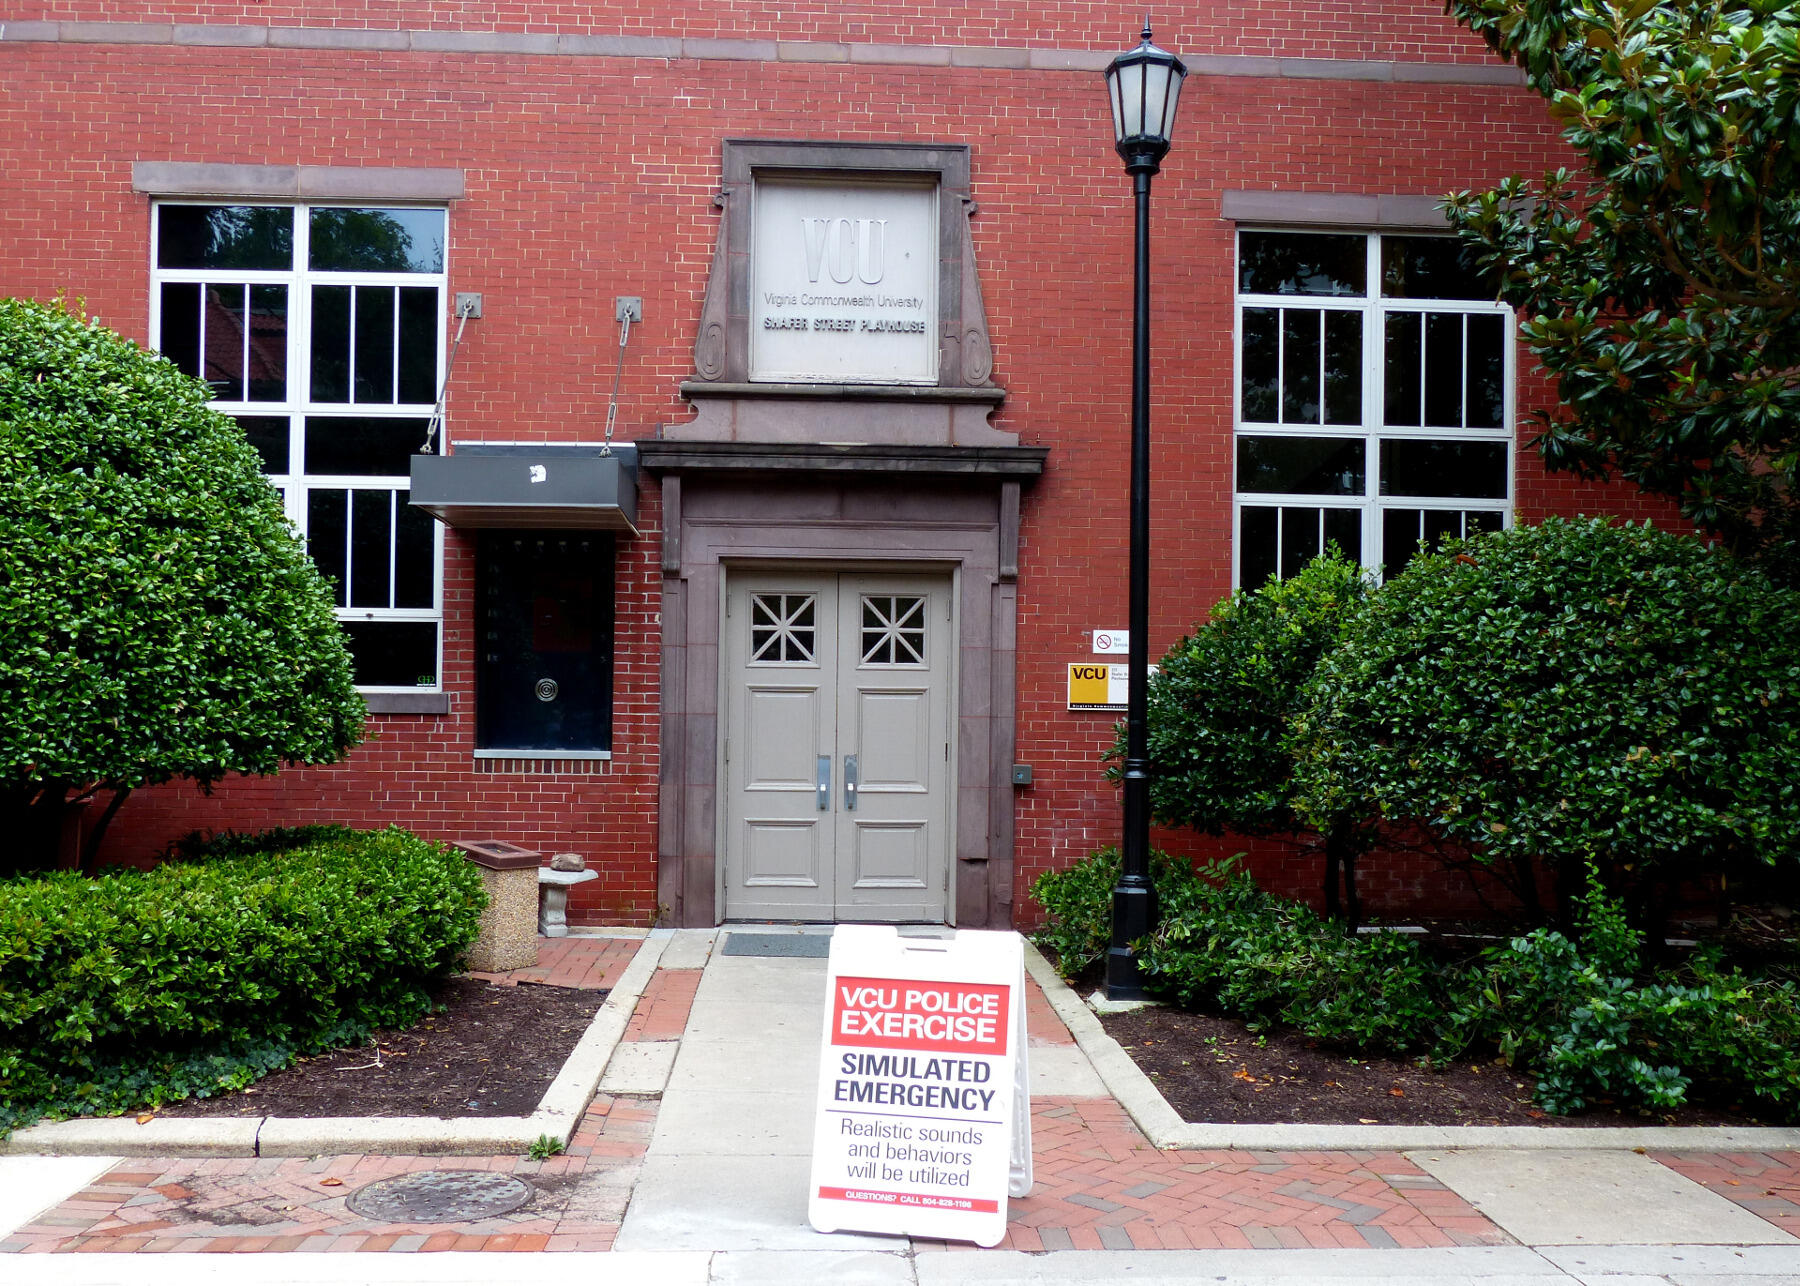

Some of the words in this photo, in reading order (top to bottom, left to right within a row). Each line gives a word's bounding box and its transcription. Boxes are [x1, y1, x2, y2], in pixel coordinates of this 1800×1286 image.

[802, 218, 888, 285] VCU
[764, 292, 797, 308] Virginia
[801, 293, 875, 307] Commonwealth
[877, 294, 924, 310] University
[764, 317, 808, 331] SHAFER
[813, 318, 856, 332] STREET
[860, 319, 926, 334] PLAYHOUSE
[1072, 667, 1106, 680] VCU
[841, 987, 897, 1008] VCU
[905, 990, 999, 1014] POLICE
[840, 1010, 997, 1043] EXERCISE
[841, 1052, 991, 1083] SIMULATED
[834, 1079, 996, 1112] EMERGENCY
[841, 1117, 913, 1140] Realistic
[918, 1126, 983, 1145] sounds
[848, 1142, 880, 1159] and
[886, 1142, 973, 1166] behaviors
[847, 1161, 878, 1179] will
[882, 1163, 903, 1181] be
[909, 1166, 970, 1187] utilized
[845, 1190, 897, 1202] QUESTIONS?
[900, 1194, 921, 1205] CALL
